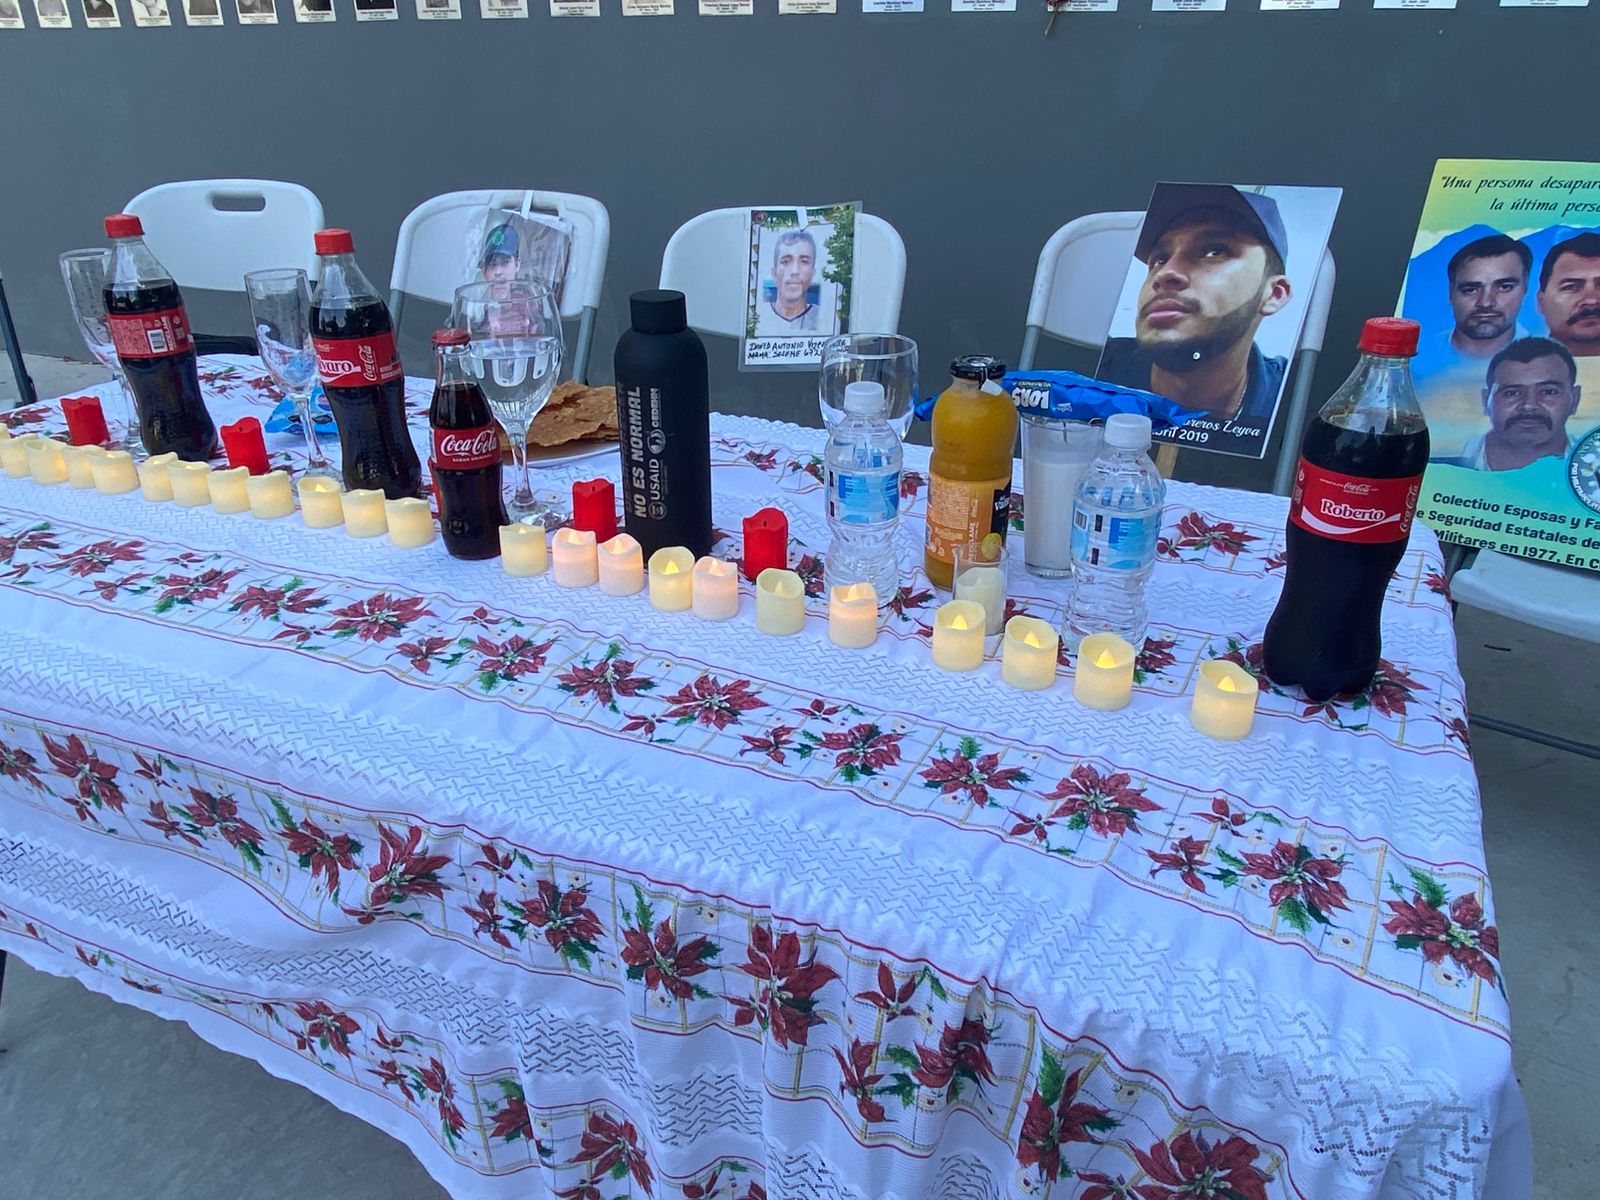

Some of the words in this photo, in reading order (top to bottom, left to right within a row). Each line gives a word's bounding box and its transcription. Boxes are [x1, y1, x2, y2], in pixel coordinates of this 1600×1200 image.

[1475, 179, 1533, 194] persona
[1540, 176, 1600, 195] desapar
[1490, 198, 1504, 210] la
[1510, 199, 1558, 211] última
[628, 386, 644, 462] NORMAL
[1184, 419, 1220, 431] reros
[441, 428, 497, 456] Coca-Cola
[1179, 430, 1209, 443] 2019
[632, 466, 645, 489] ES
[650, 458, 661, 500] USAID
[634, 495, 647, 518] NO
[1322, 500, 1384, 521] Roberto
[1433, 493, 1500, 512] Colectivo
[1503, 504, 1566, 524] Esposas
[1570, 517, 1581, 529] y
[1428, 510, 1502, 531] Seguridad
[1505, 524, 1577, 545] Estatales
[1434, 529, 1496, 550] Militares
[1500, 543, 1523, 554] en
[1565, 554, 1585, 566] En
